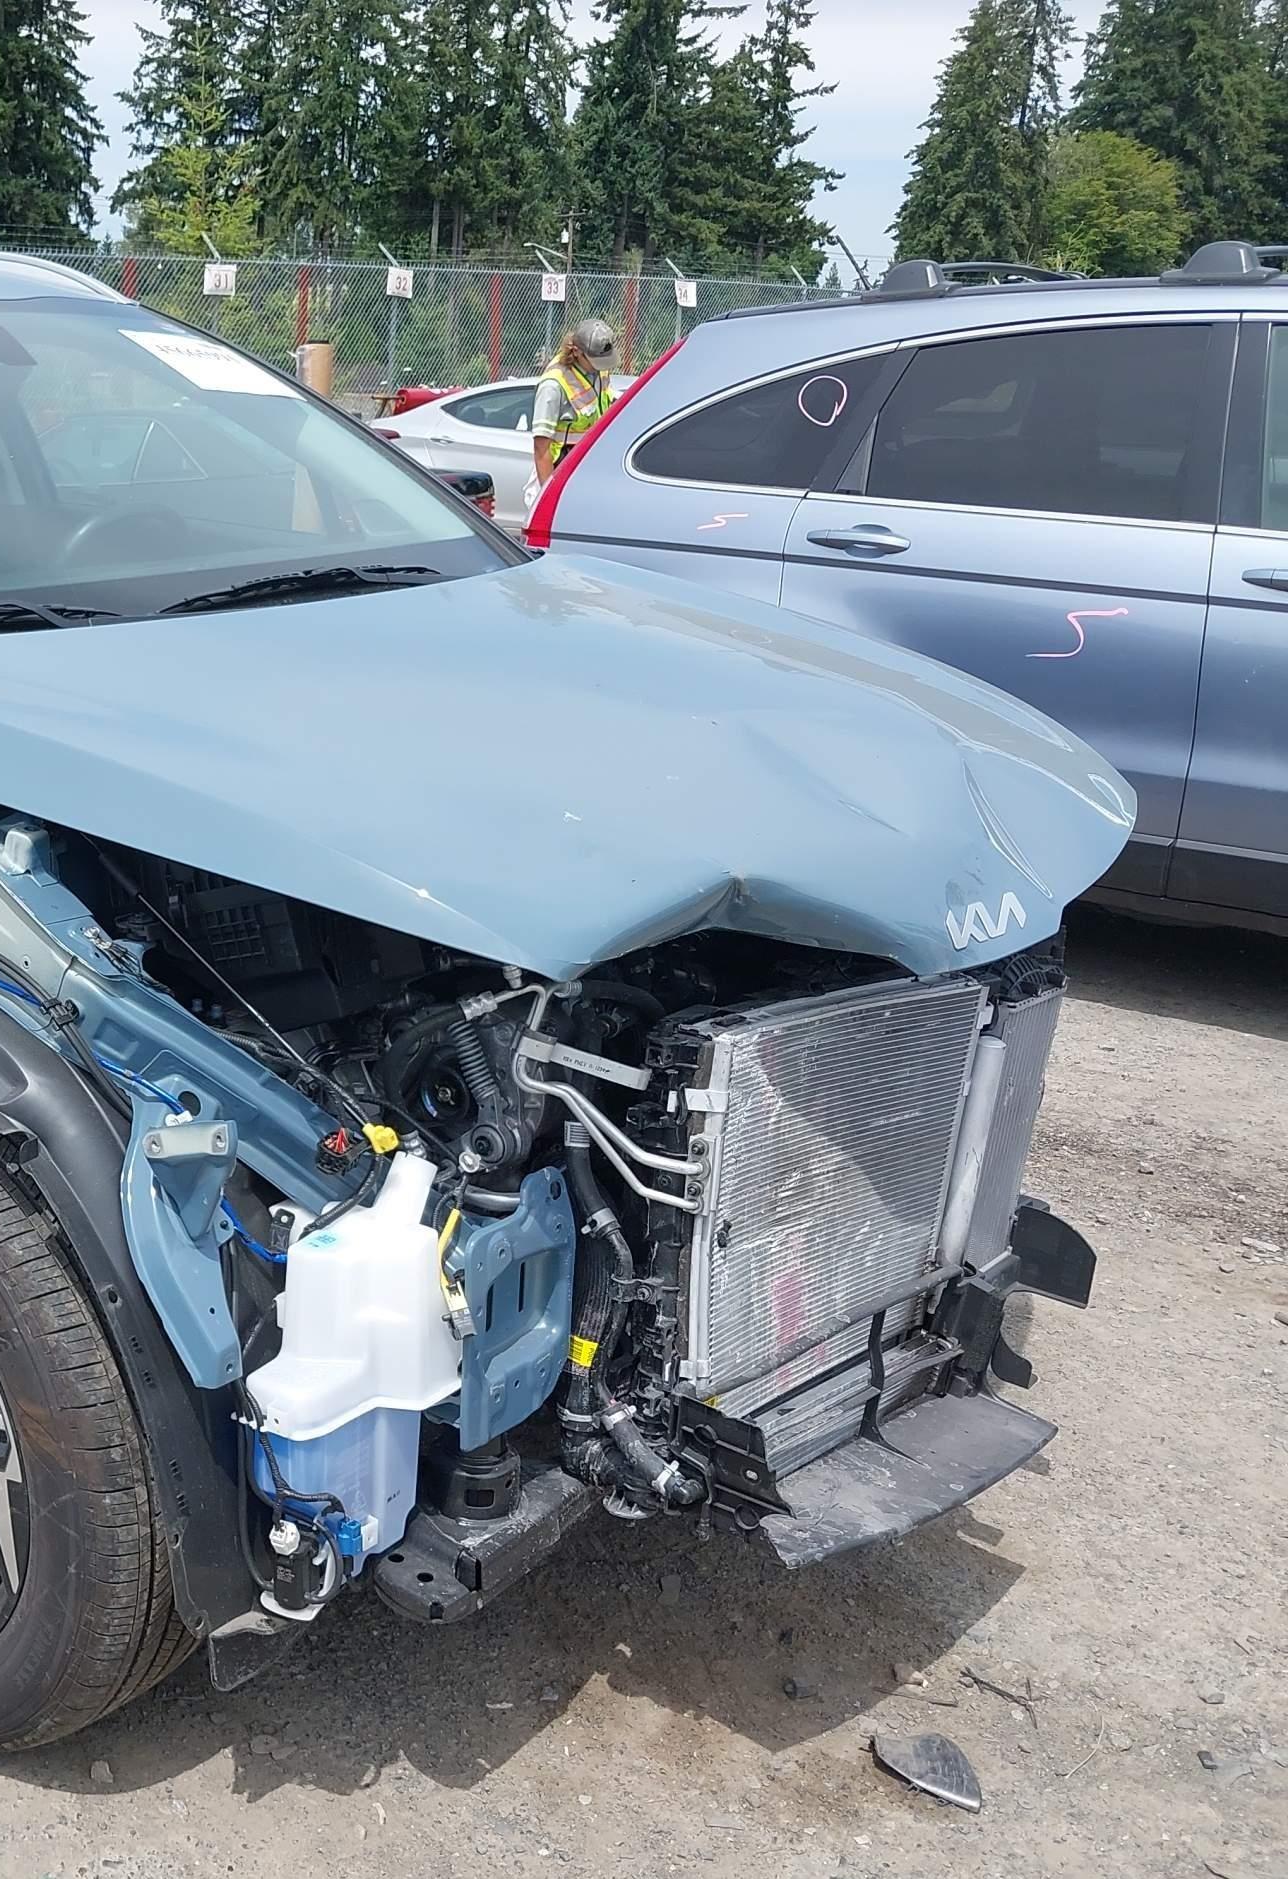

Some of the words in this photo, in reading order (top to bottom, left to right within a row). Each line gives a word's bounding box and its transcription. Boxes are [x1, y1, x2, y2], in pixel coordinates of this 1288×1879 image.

[214, 273, 228, 288] 31
[395, 276, 408, 291] 32
[546, 281, 559, 295] 33
